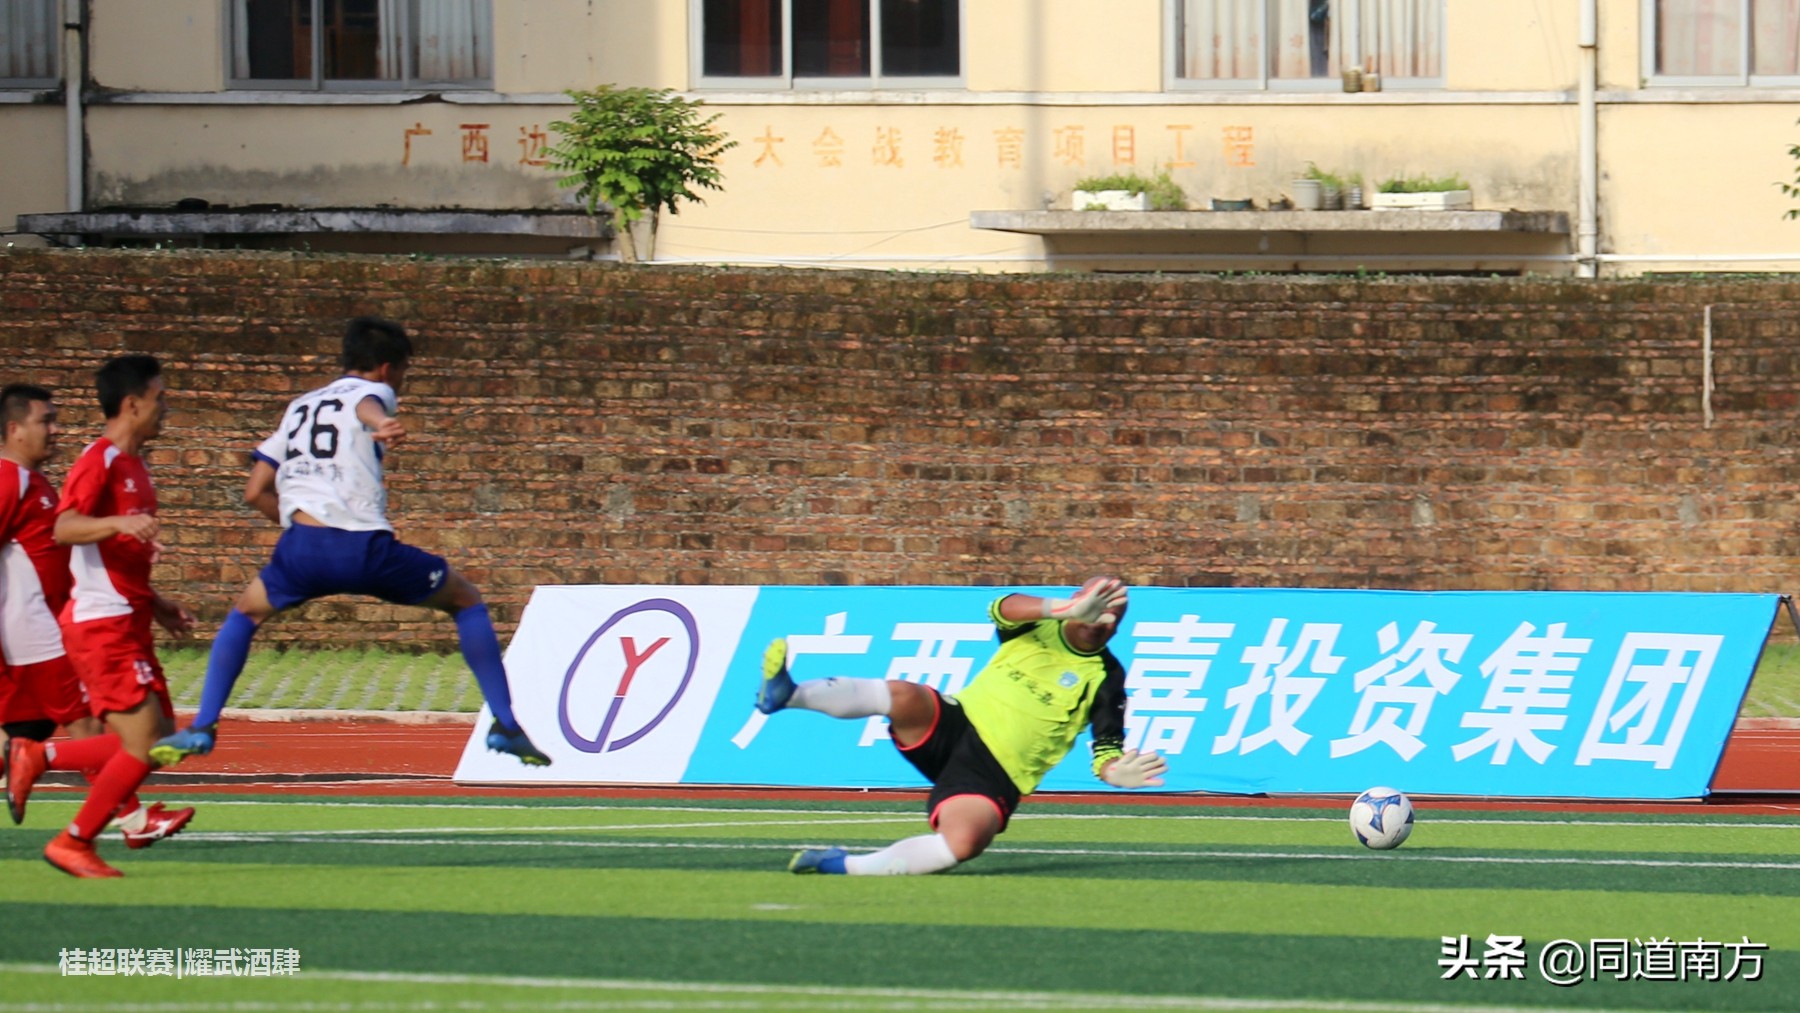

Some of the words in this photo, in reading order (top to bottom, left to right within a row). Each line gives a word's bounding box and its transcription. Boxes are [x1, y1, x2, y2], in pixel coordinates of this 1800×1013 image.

[285, 398, 344, 460] 26
[733, 611, 1725, 769] 广西嘉投资集团
